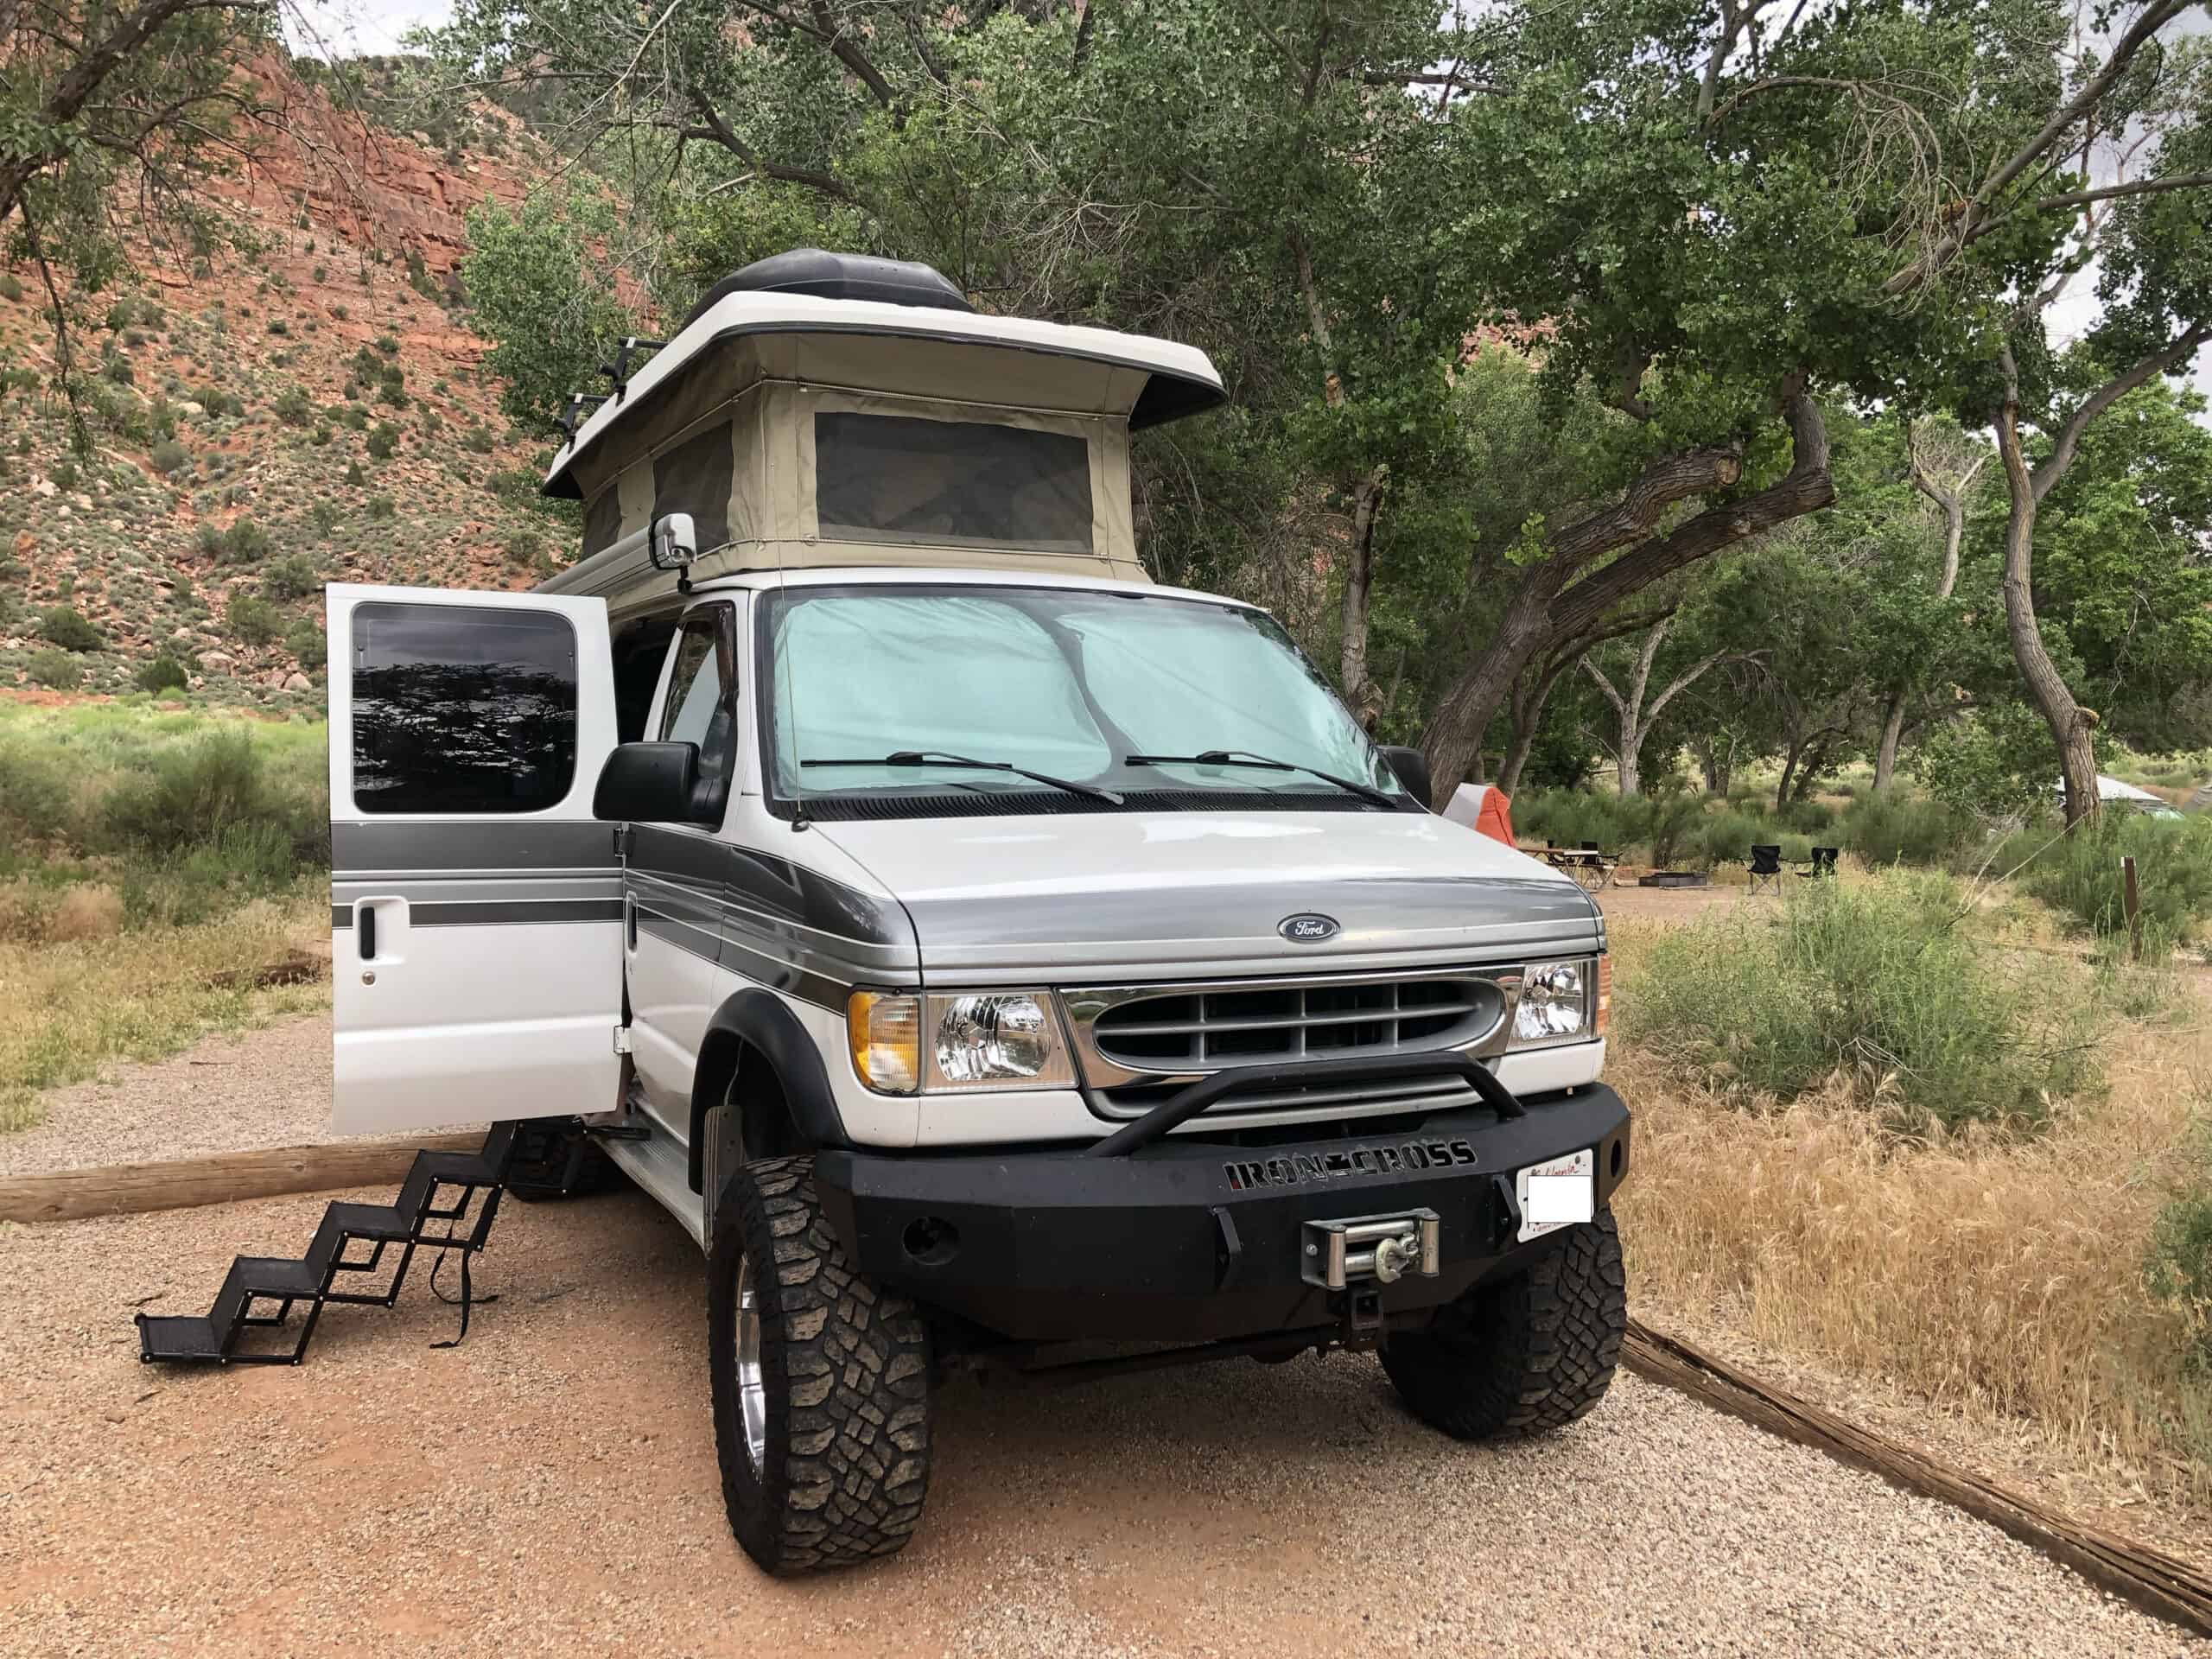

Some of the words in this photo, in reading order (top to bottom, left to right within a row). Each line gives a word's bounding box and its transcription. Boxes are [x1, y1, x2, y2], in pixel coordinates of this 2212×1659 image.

[1295, 921, 1325, 935] Ford
[1224, 1153, 1329, 1190] IRON
[1350, 1140, 1478, 1176] CROSS
